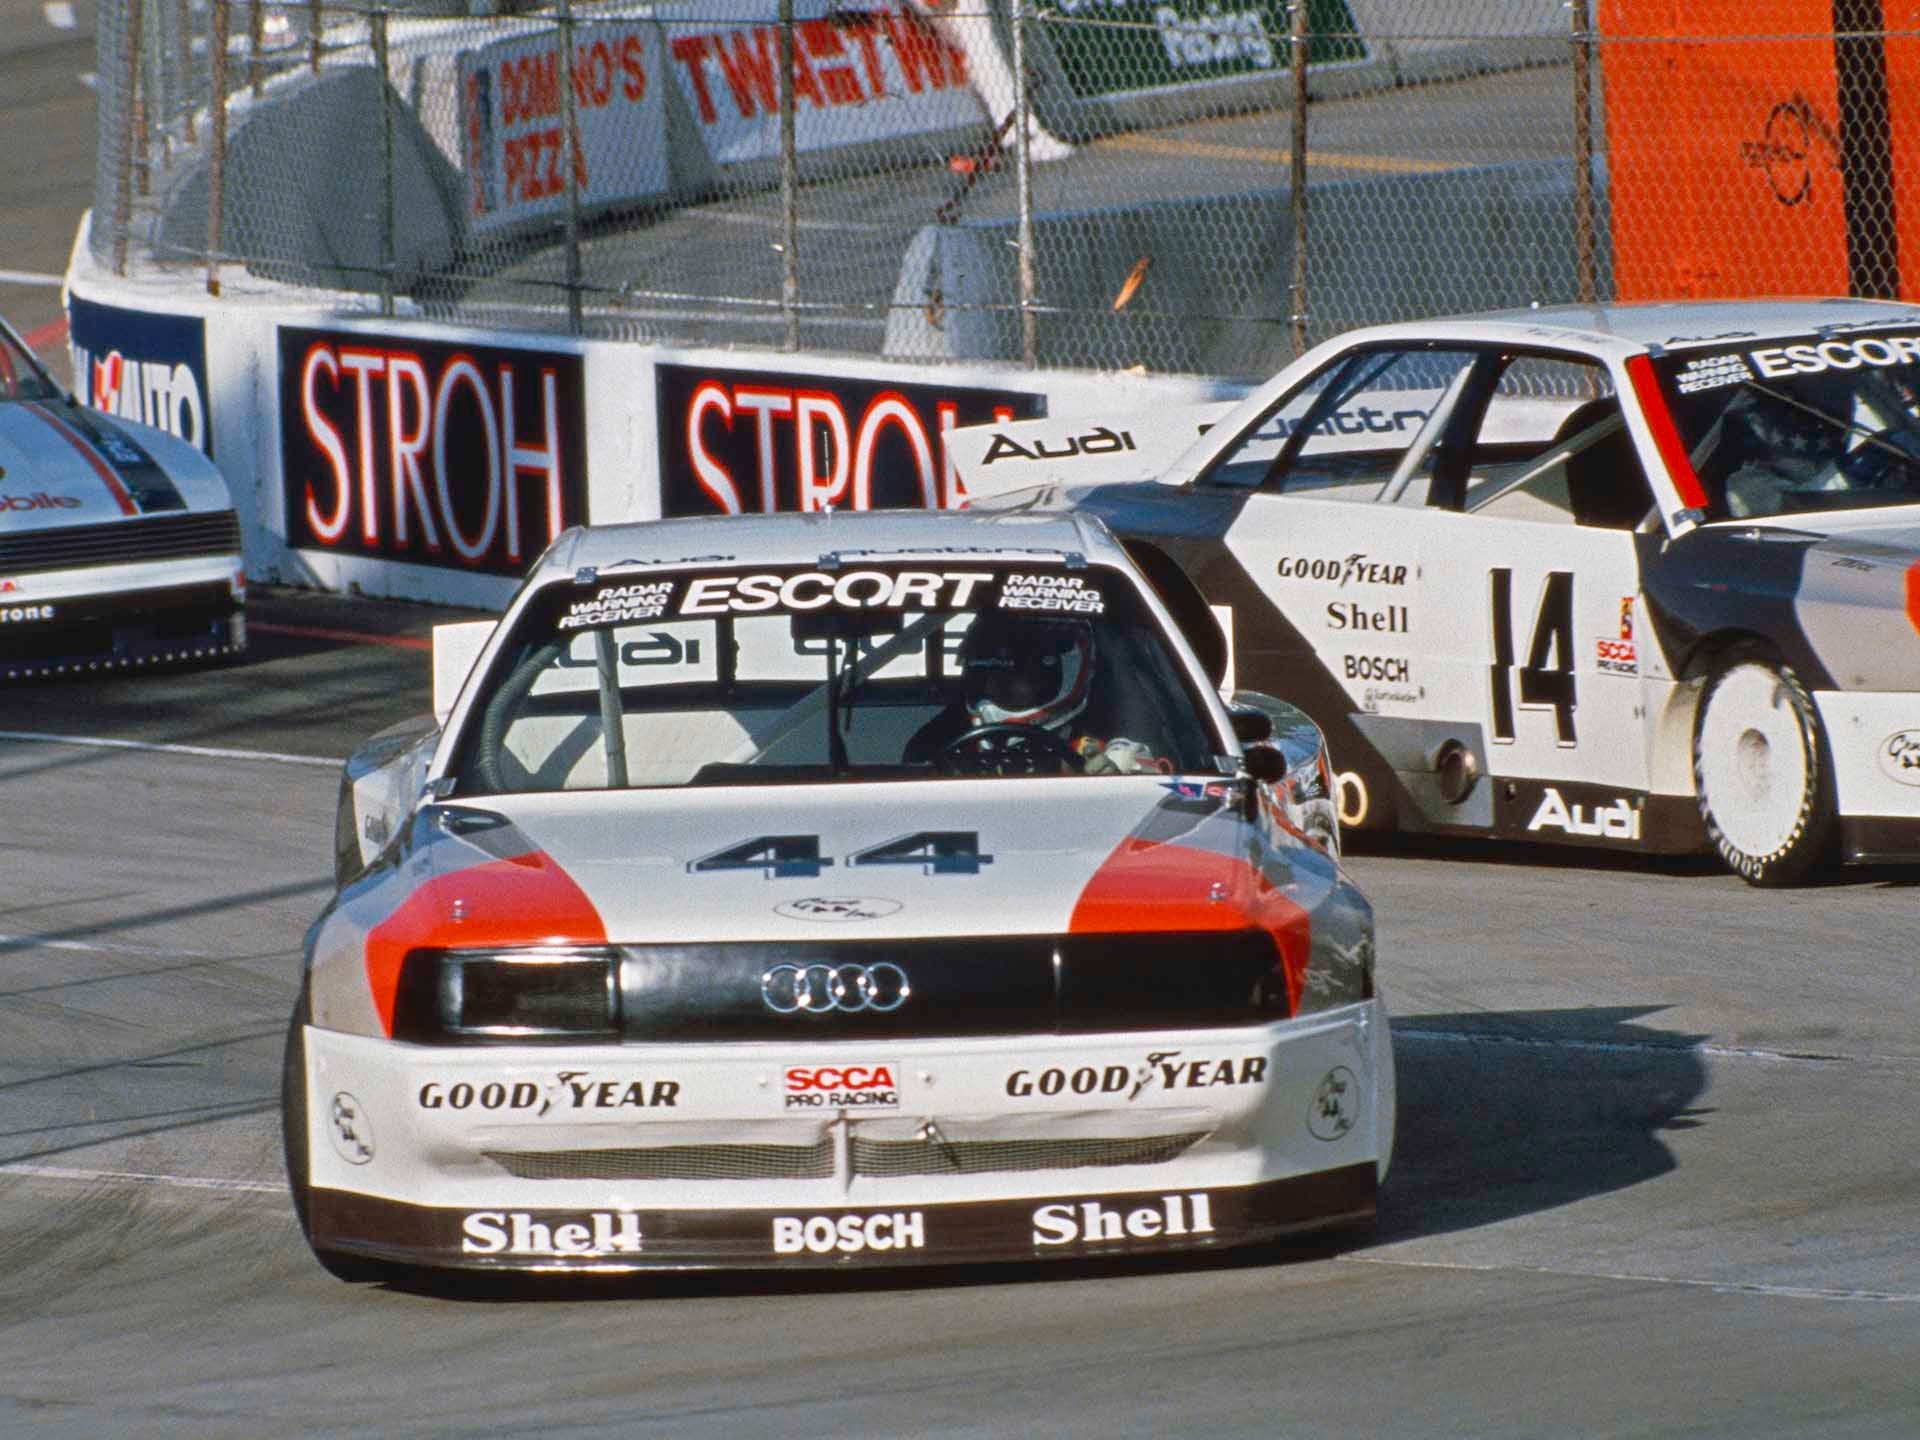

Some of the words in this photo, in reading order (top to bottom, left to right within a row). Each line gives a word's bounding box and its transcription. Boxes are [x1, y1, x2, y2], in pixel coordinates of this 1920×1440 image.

[501, 35, 647, 128] DOMNO'S
[302, 341, 563, 565] STROH
[982, 426, 1136, 465] Audi
[599, 582, 673, 600] RADAR
[679, 571, 994, 615] ESCORT
[1002, 585, 1100, 601] WARNING
[1007, 574, 1083, 590] RADAR
[558, 606, 663, 629] RECEIVER
[570, 594, 667, 615] WARNING
[998, 596, 1104, 614] RECEIVER
[1327, 602, 1408, 633] Shell
[1489, 568, 1576, 748] 14
[1596, 640, 1637, 661] SCCA
[1343, 654, 1409, 683] BOSCH
[1527, 788, 1641, 840] Audi
[687, 831, 993, 880] 44
[785, 1066, 894, 1091] SCCA
[785, 1093, 824, 1107] PRO
[830, 1091, 898, 1106] RACING
[462, 1211, 642, 1255] Shell
[773, 1212, 924, 1253] BOSCH
[1032, 1193, 1216, 1245] Shell
